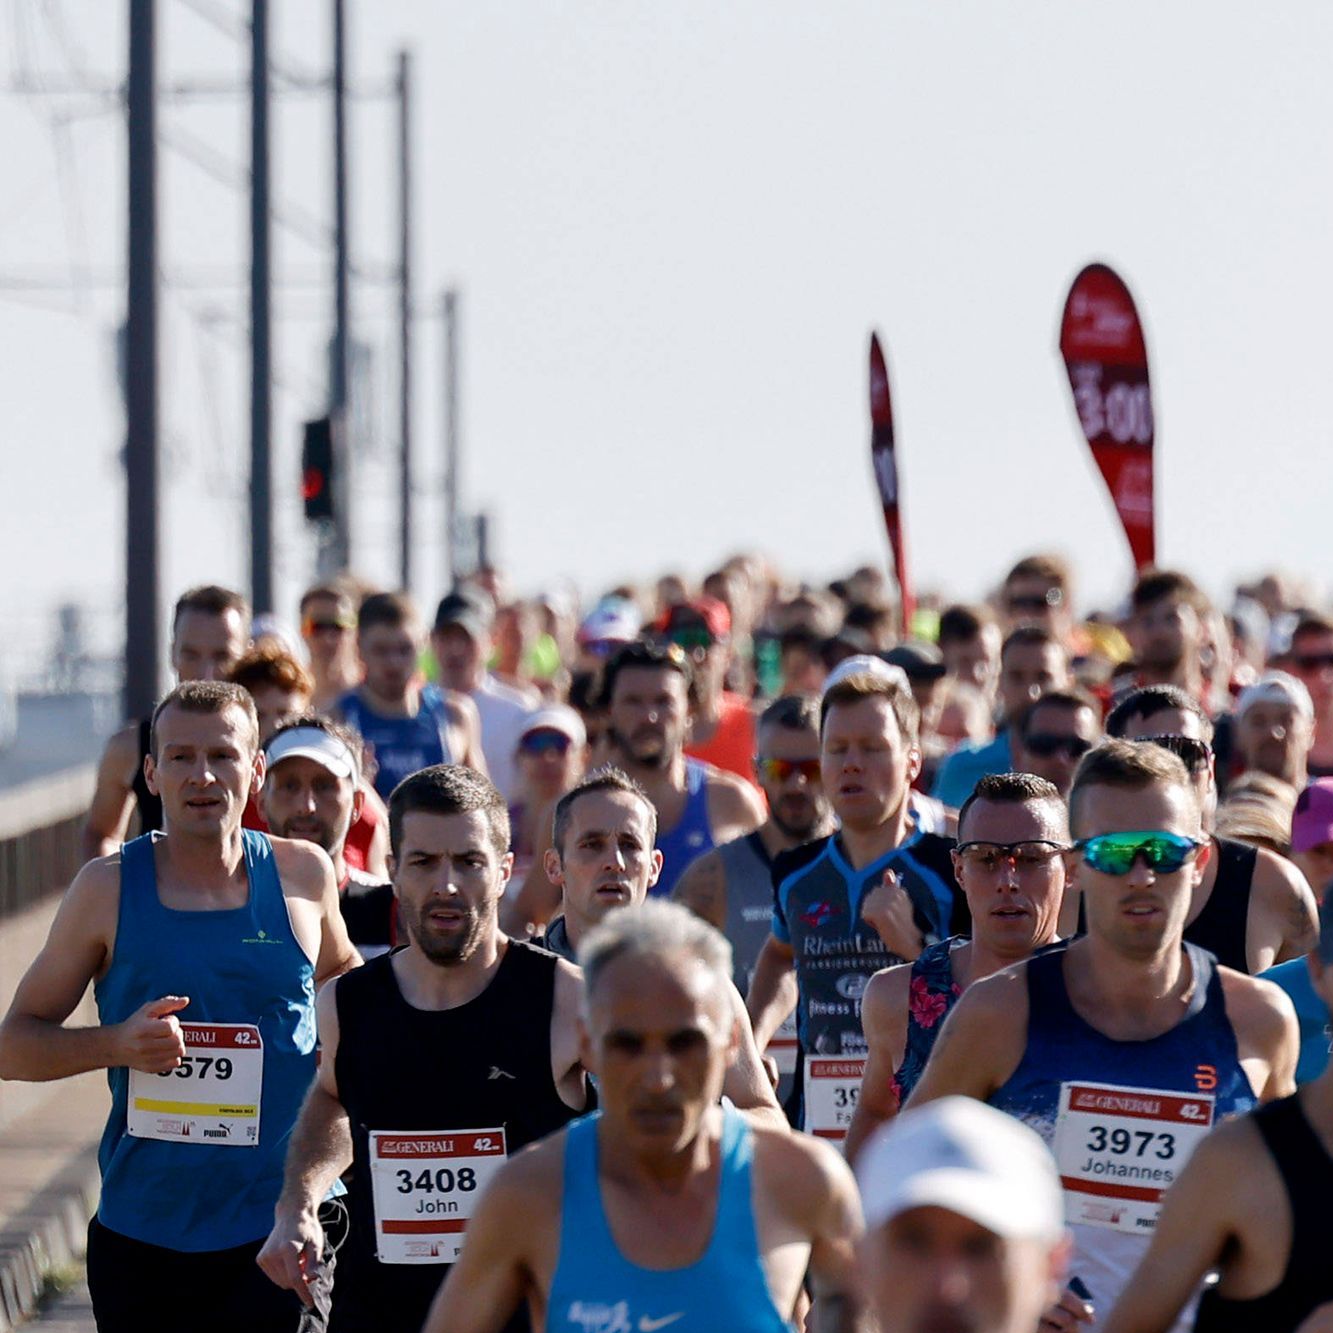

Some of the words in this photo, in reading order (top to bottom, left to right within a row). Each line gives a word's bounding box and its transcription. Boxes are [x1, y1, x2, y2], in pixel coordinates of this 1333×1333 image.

[184, 1030, 216, 1043] ERALI
[157, 1057, 233, 1080] 579
[396, 1140, 454, 1153] GENERALI
[1087, 1126, 1176, 1160] 3973
[396, 1167, 477, 1194] 3408
[1081, 1157, 1174, 1183] Johannes
[415, 1199, 458, 1214] John
